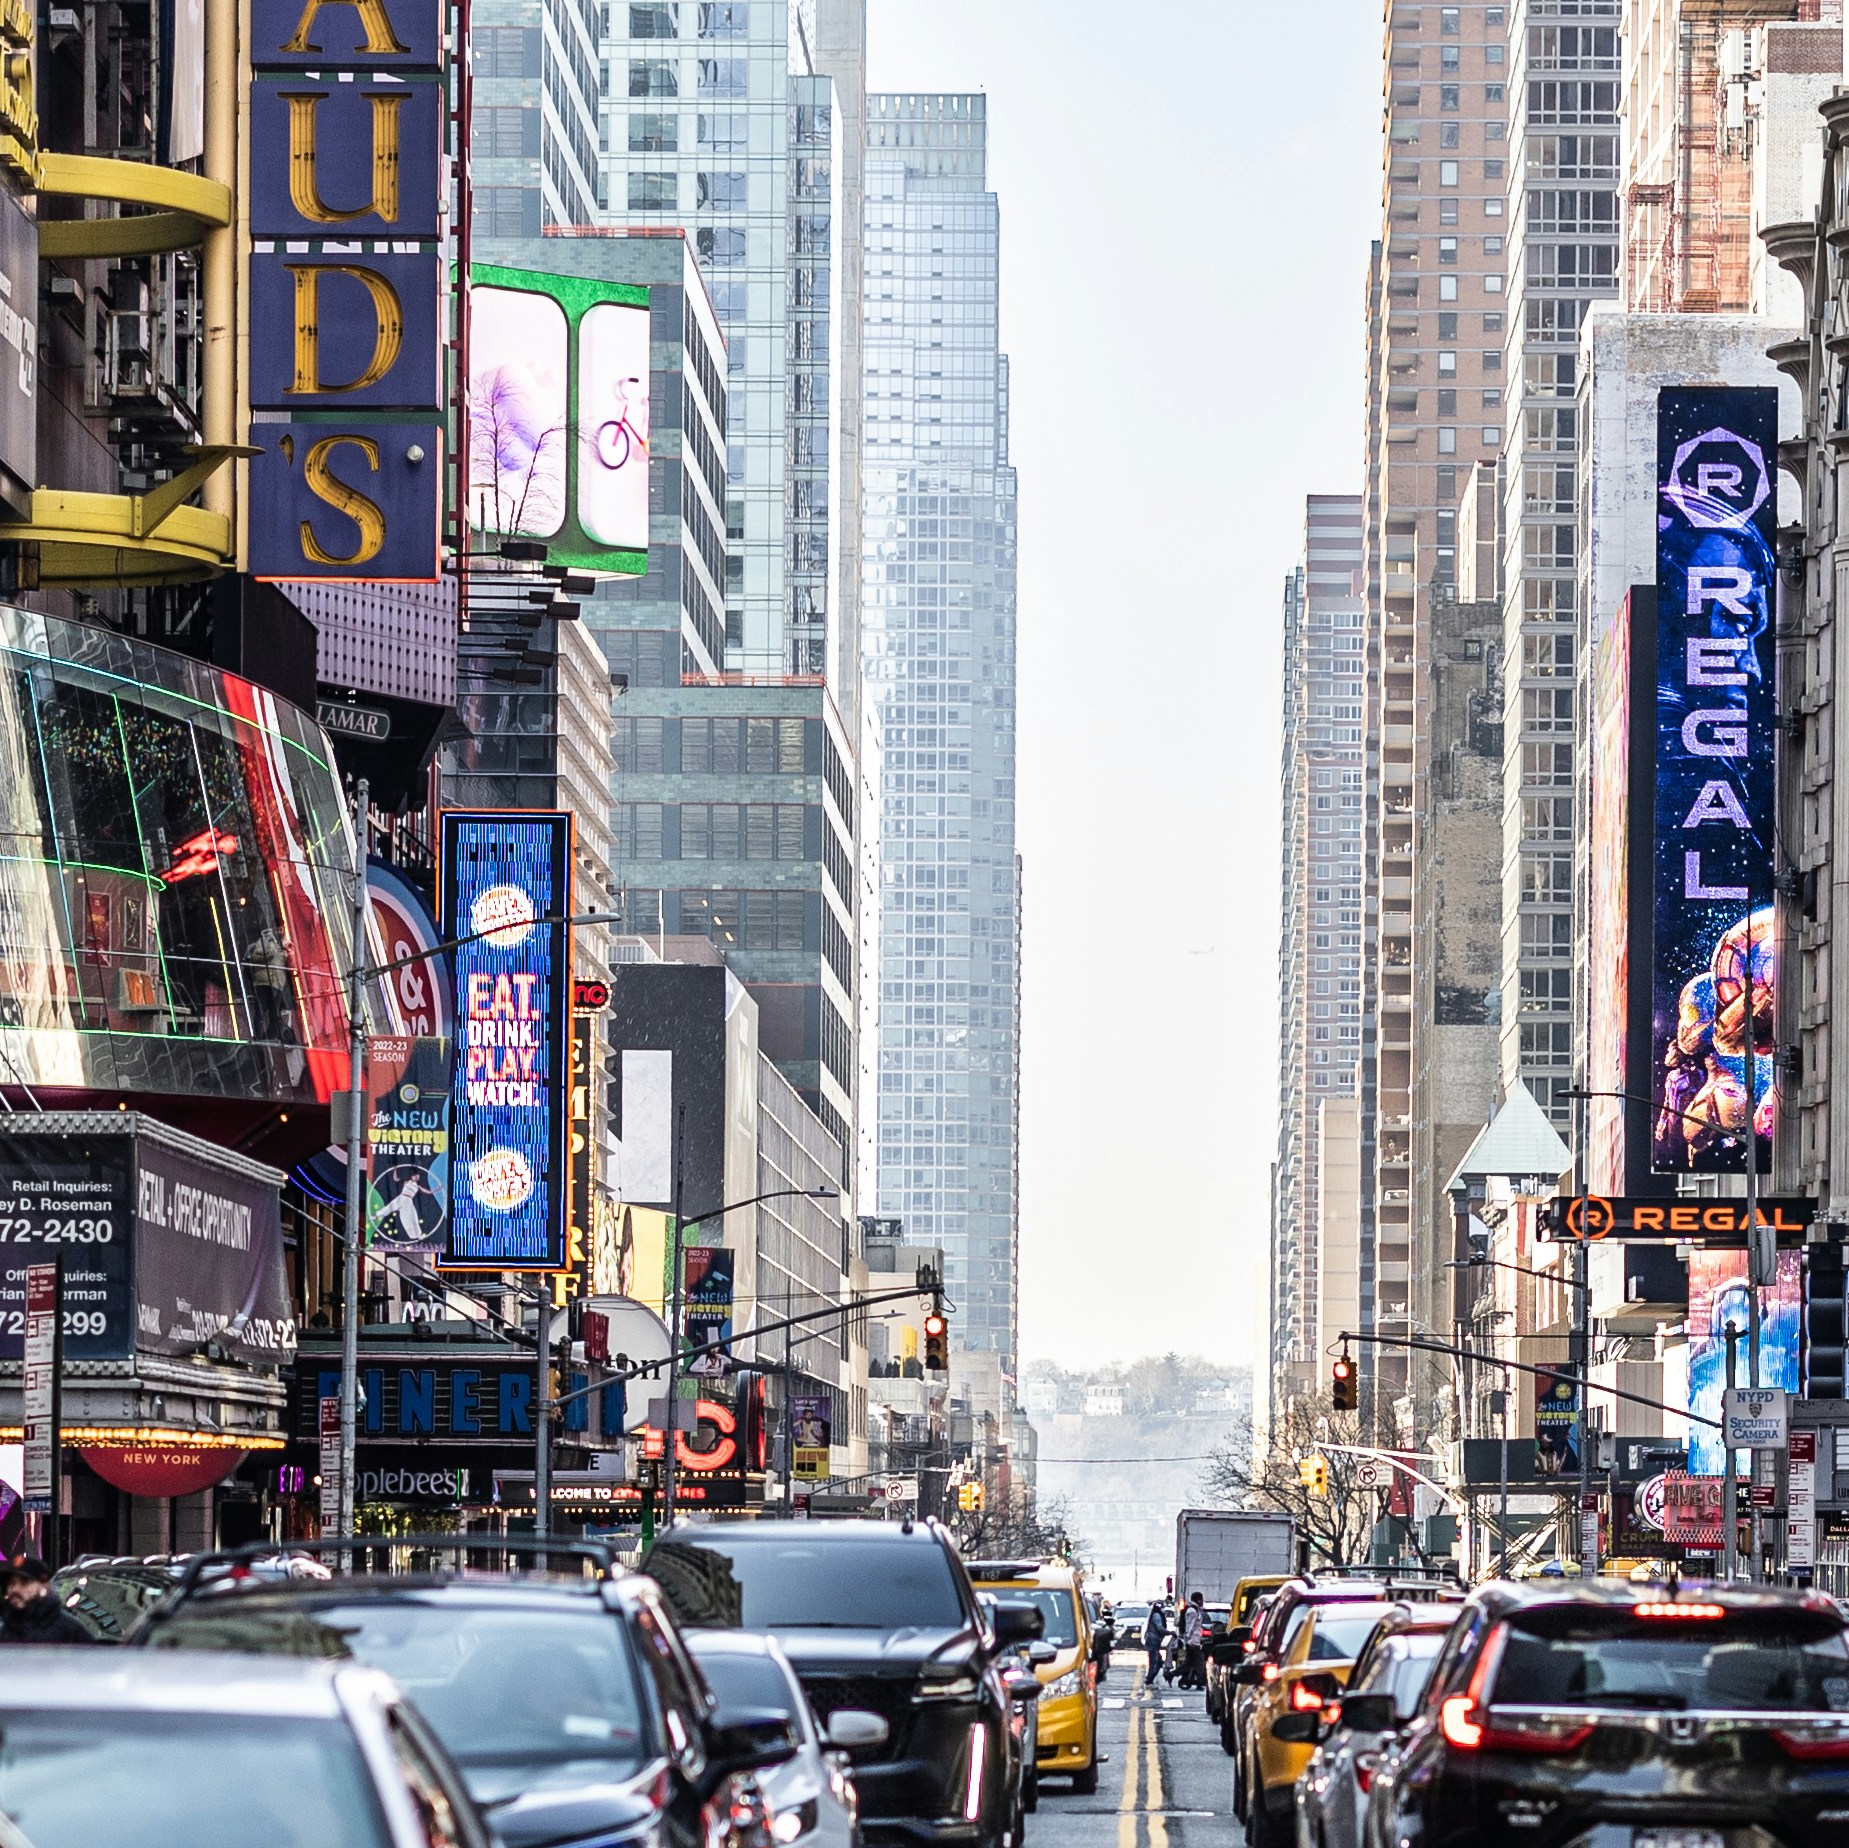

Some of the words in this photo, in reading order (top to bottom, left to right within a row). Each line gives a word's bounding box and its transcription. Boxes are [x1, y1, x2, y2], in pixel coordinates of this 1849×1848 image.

[1697, 464, 1743, 498] R
[316, 703, 378, 735] LAMAR
[1682, 566, 1752, 900] REGAL
[468, 972, 540, 1020] EAT.
[468, 1020, 540, 1048] DRINK.
[373, 1052, 405, 1063] SEASON
[468, 1047, 540, 1082] PLAY.
[468, 1081, 540, 1107] WATCH.
[371, 1110, 392, 1128] The
[393, 1110, 439, 1129] NEW
[370, 1143, 432, 1156] THEATER
[13, 1180, 48, 1193] Retail
[54, 1180, 112, 1195] Inquiries:
[25, 1199, 37, 1212] D.
[42, 1199, 113, 1212] Roseman
[138, 1168, 166, 1227] RETAIL
[174, 1182, 201, 1238] OFFICE
[202, 1191, 252, 1251] OPPORTUNITY
[1633, 1207, 1804, 1231] REGAL
[1548, 1401, 1572, 1411] NEW
[1736, 1392, 1774, 1403] NYPD
[1730, 1417, 1781, 1429] SECURITY
[1732, 1428, 1779, 1440] CAMERA
[123, 1453, 153, 1466] NEW
[158, 1454, 201, 1467] YORK
[354, 1468, 458, 1500] plebee's
[595, 1487, 611, 1499] TO
[1666, 1483, 1706, 1507] FIVE
[1392, 1590, 1434, 1601] TAXI
